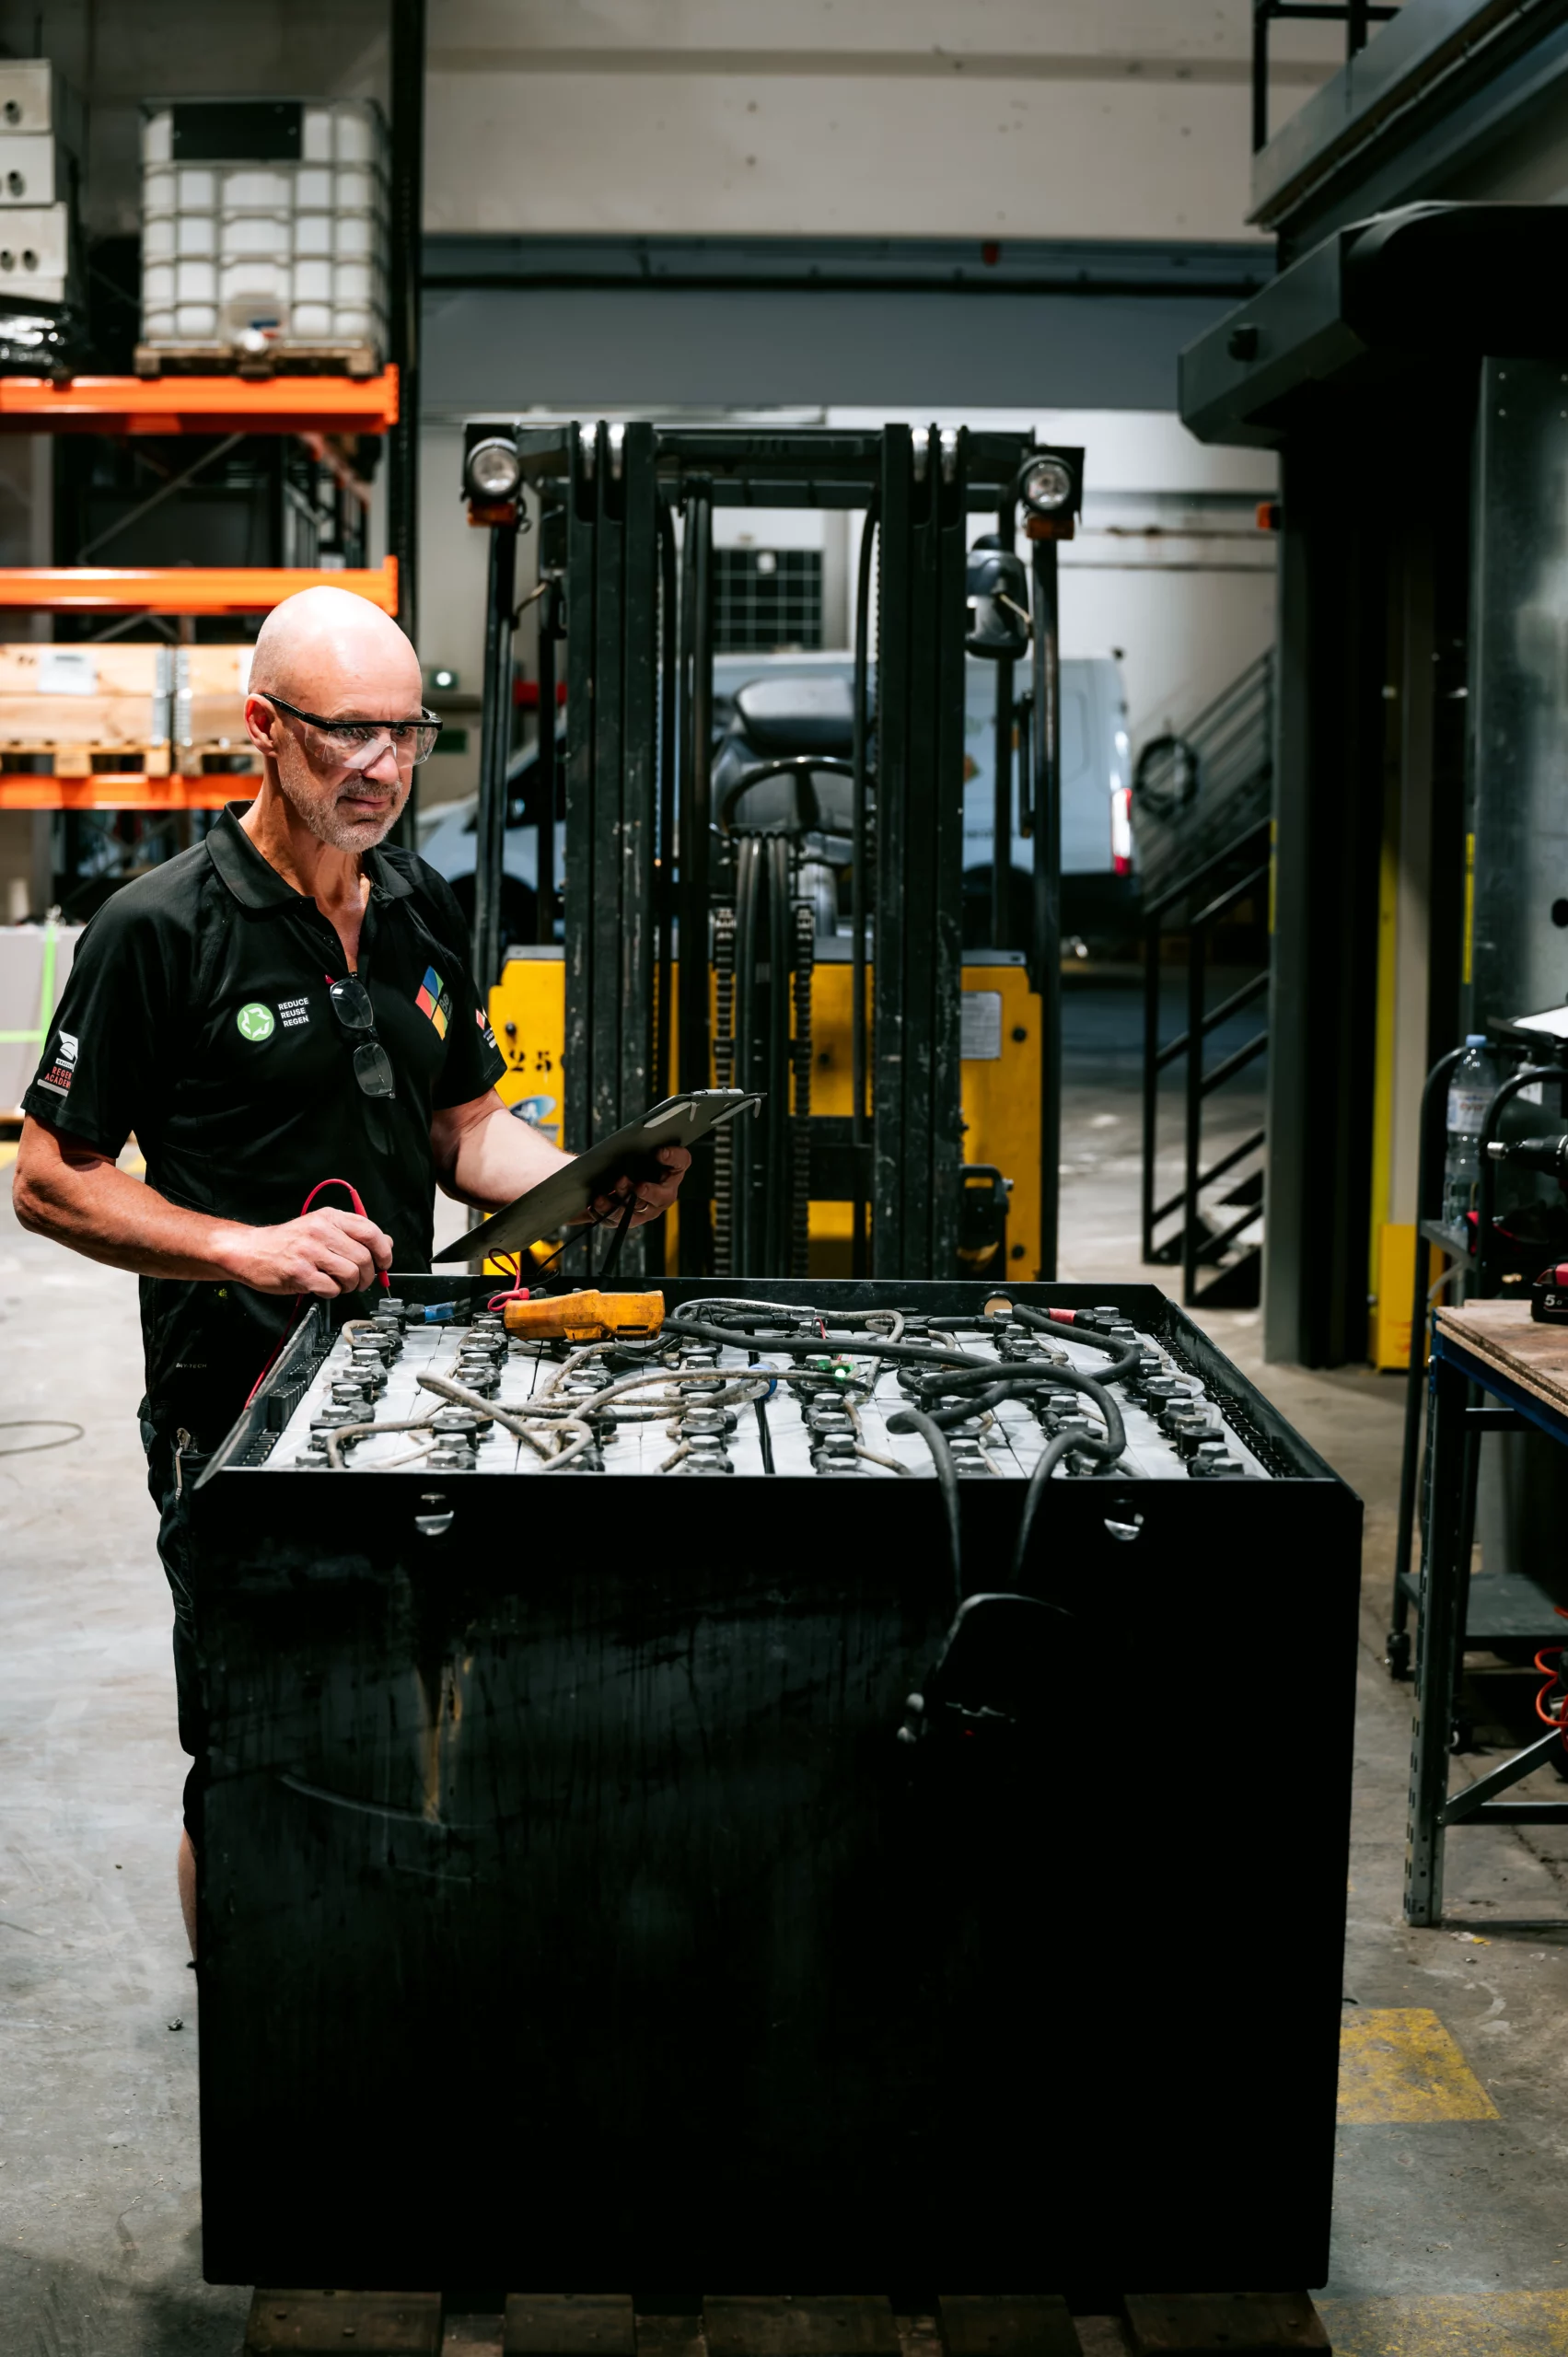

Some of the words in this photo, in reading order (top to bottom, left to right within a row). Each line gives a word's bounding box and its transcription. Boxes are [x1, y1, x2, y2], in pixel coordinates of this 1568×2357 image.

[278, 997, 308, 1010] REDUCE
[281, 1007, 306, 1018] REUSE
[283, 1015, 308, 1027] REGEN
[45, 1073, 70, 1088] ACADEM
